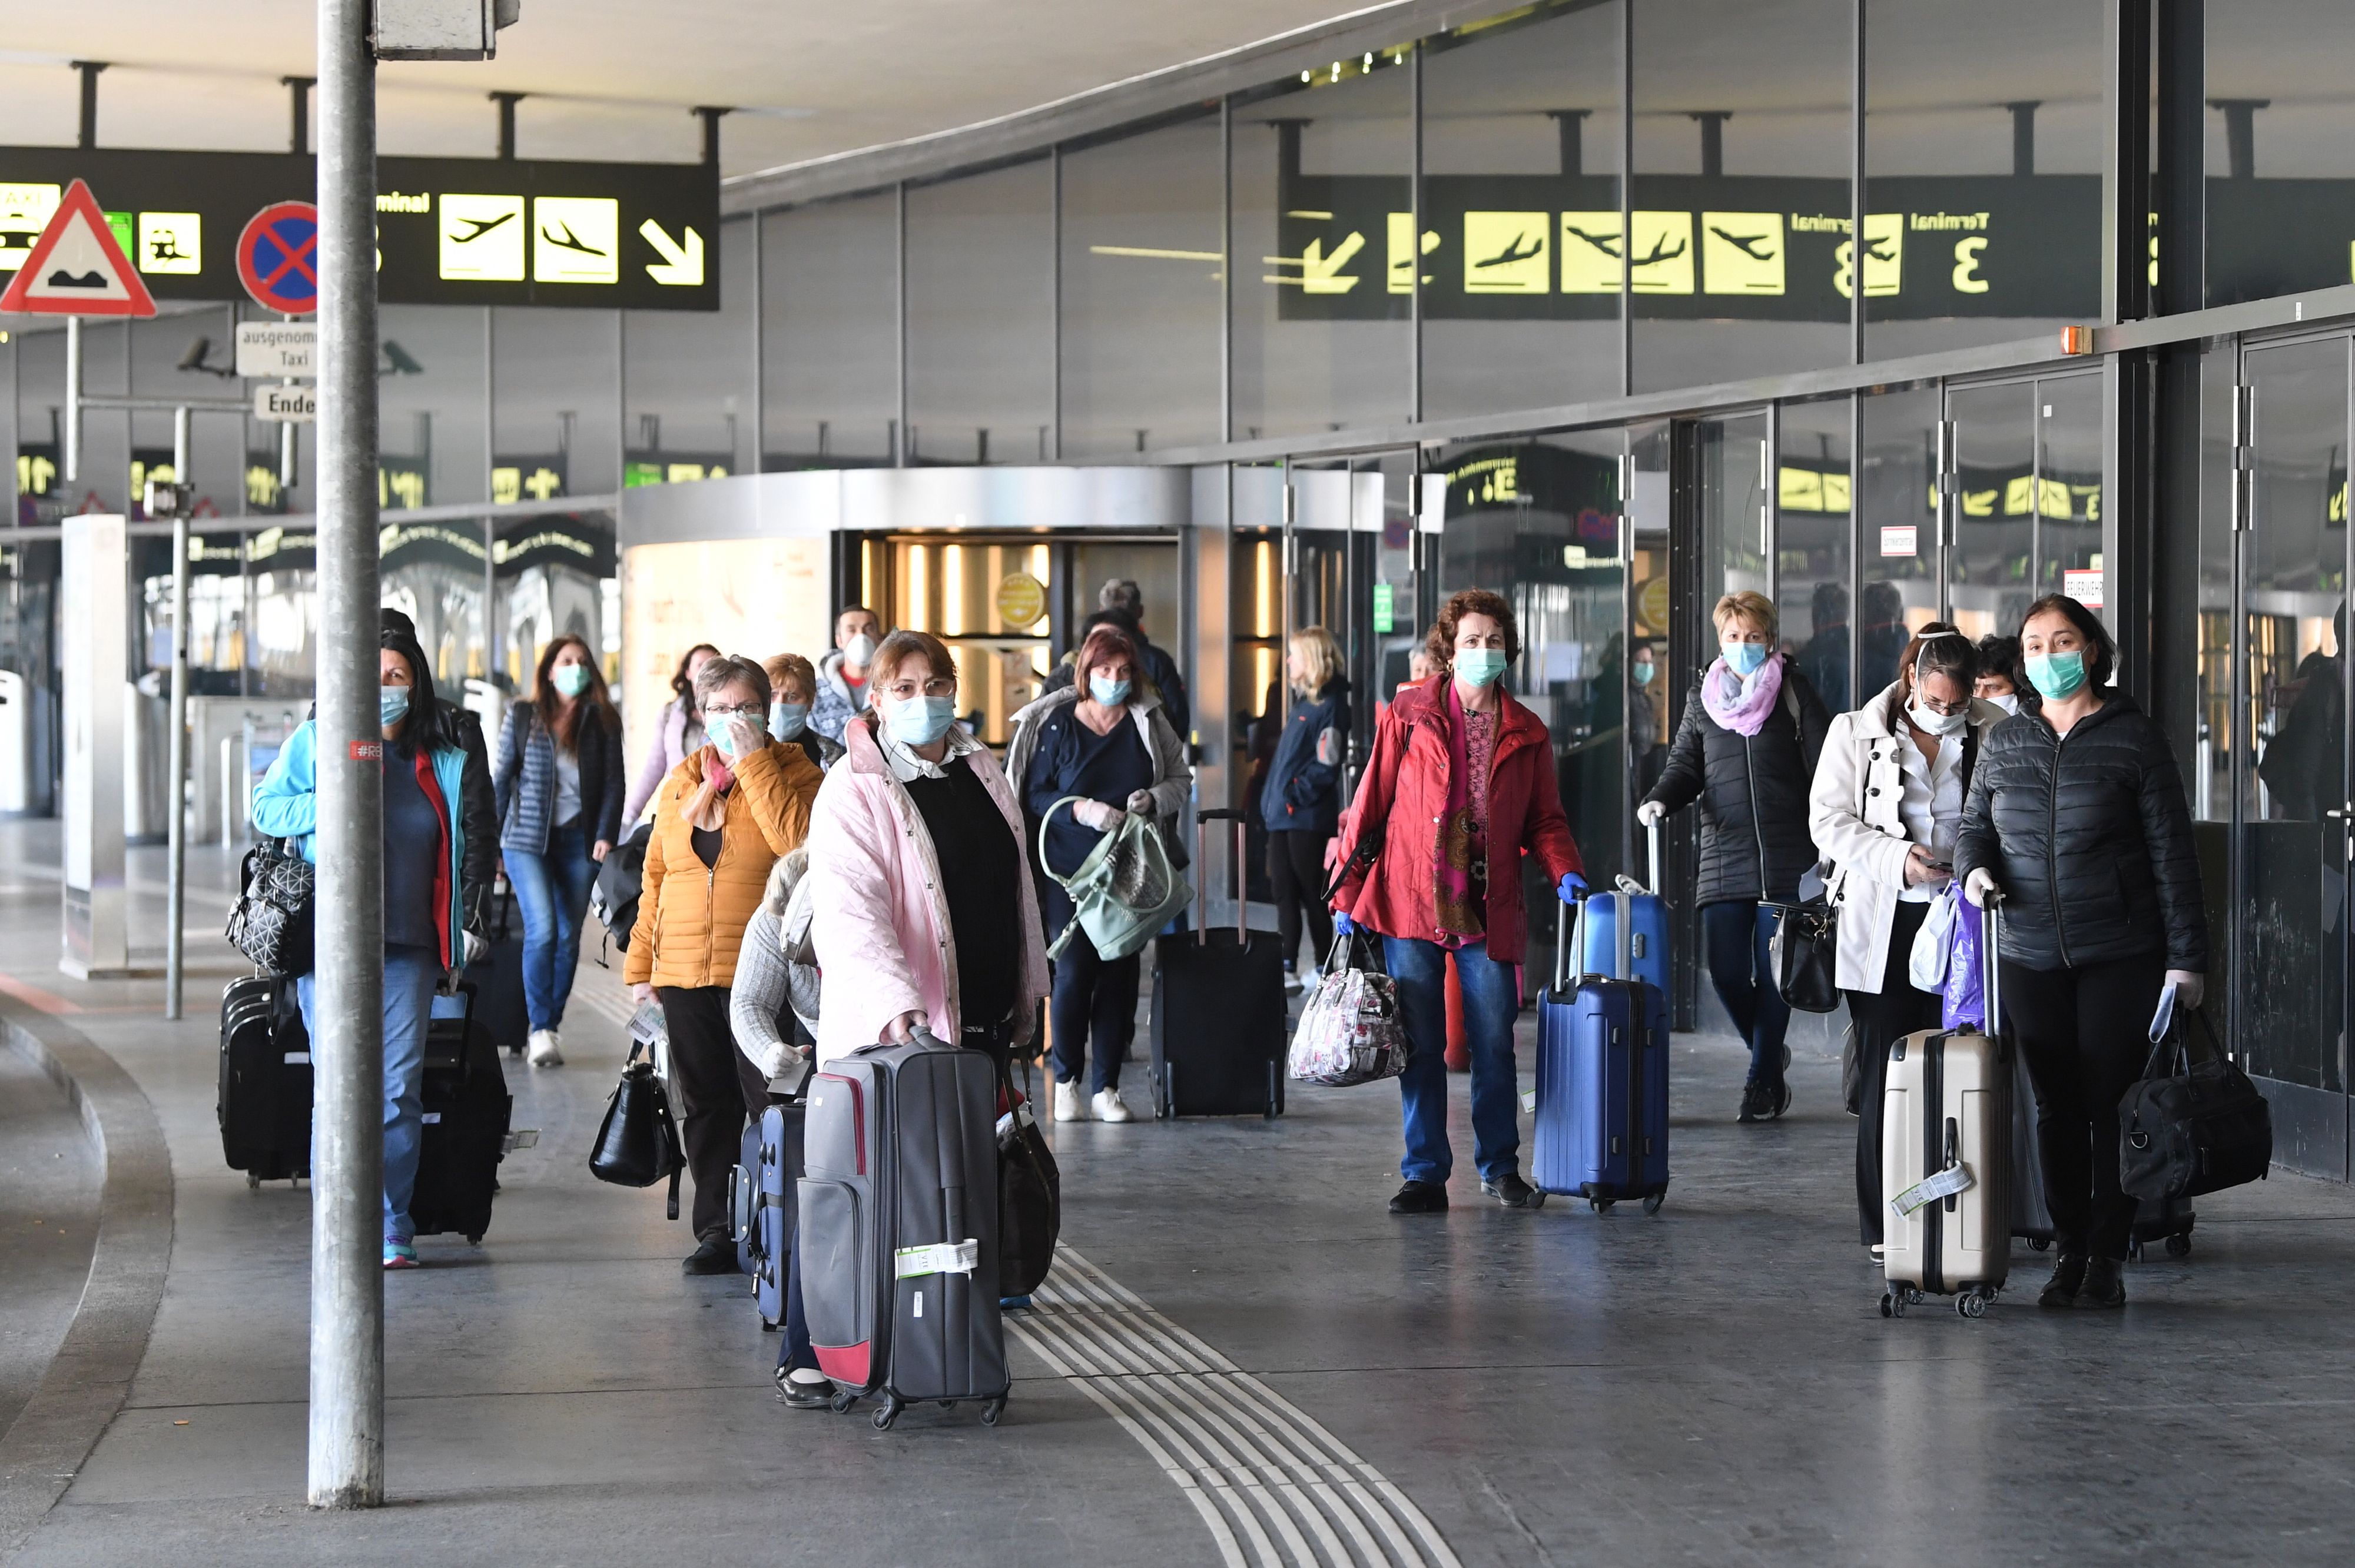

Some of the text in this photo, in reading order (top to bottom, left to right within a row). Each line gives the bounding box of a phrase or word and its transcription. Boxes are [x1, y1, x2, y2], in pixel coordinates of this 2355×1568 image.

[376, 191, 430, 213] minal
[243, 331, 317, 348] ausgenom
[280, 350, 308, 366] Taxi
[269, 393, 315, 413] Ende
